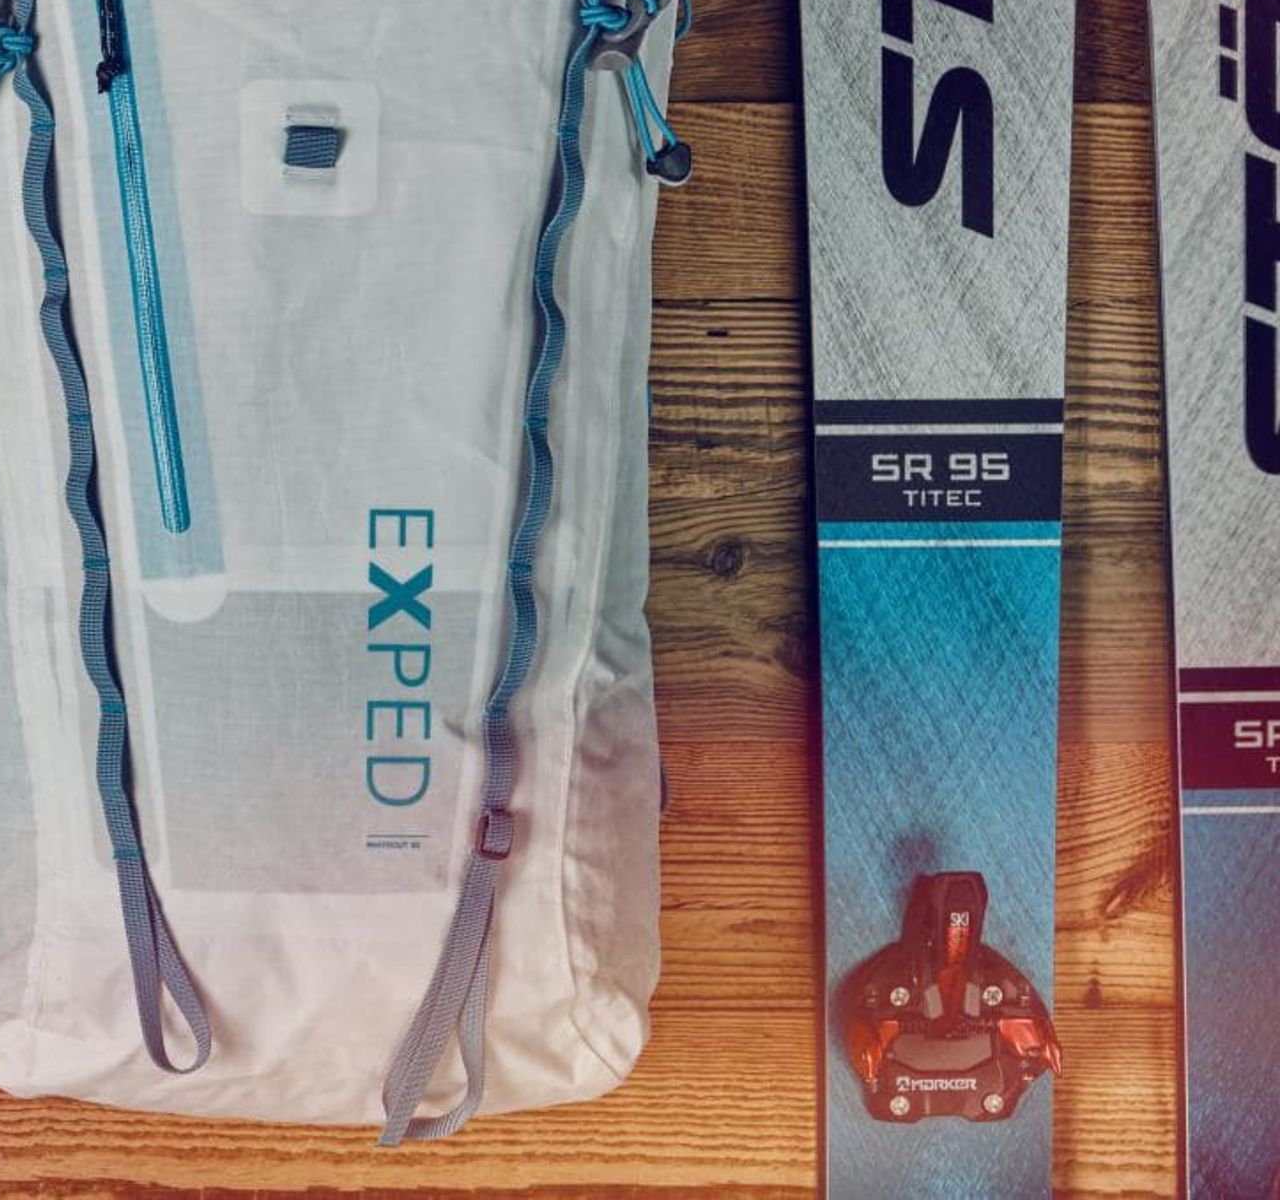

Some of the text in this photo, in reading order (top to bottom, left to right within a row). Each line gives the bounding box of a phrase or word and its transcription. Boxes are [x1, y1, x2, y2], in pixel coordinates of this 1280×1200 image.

[872, 454, 1010, 480] SR 95
[903, 489, 981, 507] TITEC
[367, 508, 435, 808] EXPED
[950, 912, 969, 927] SKI
[911, 1077, 977, 1091] MARKER
